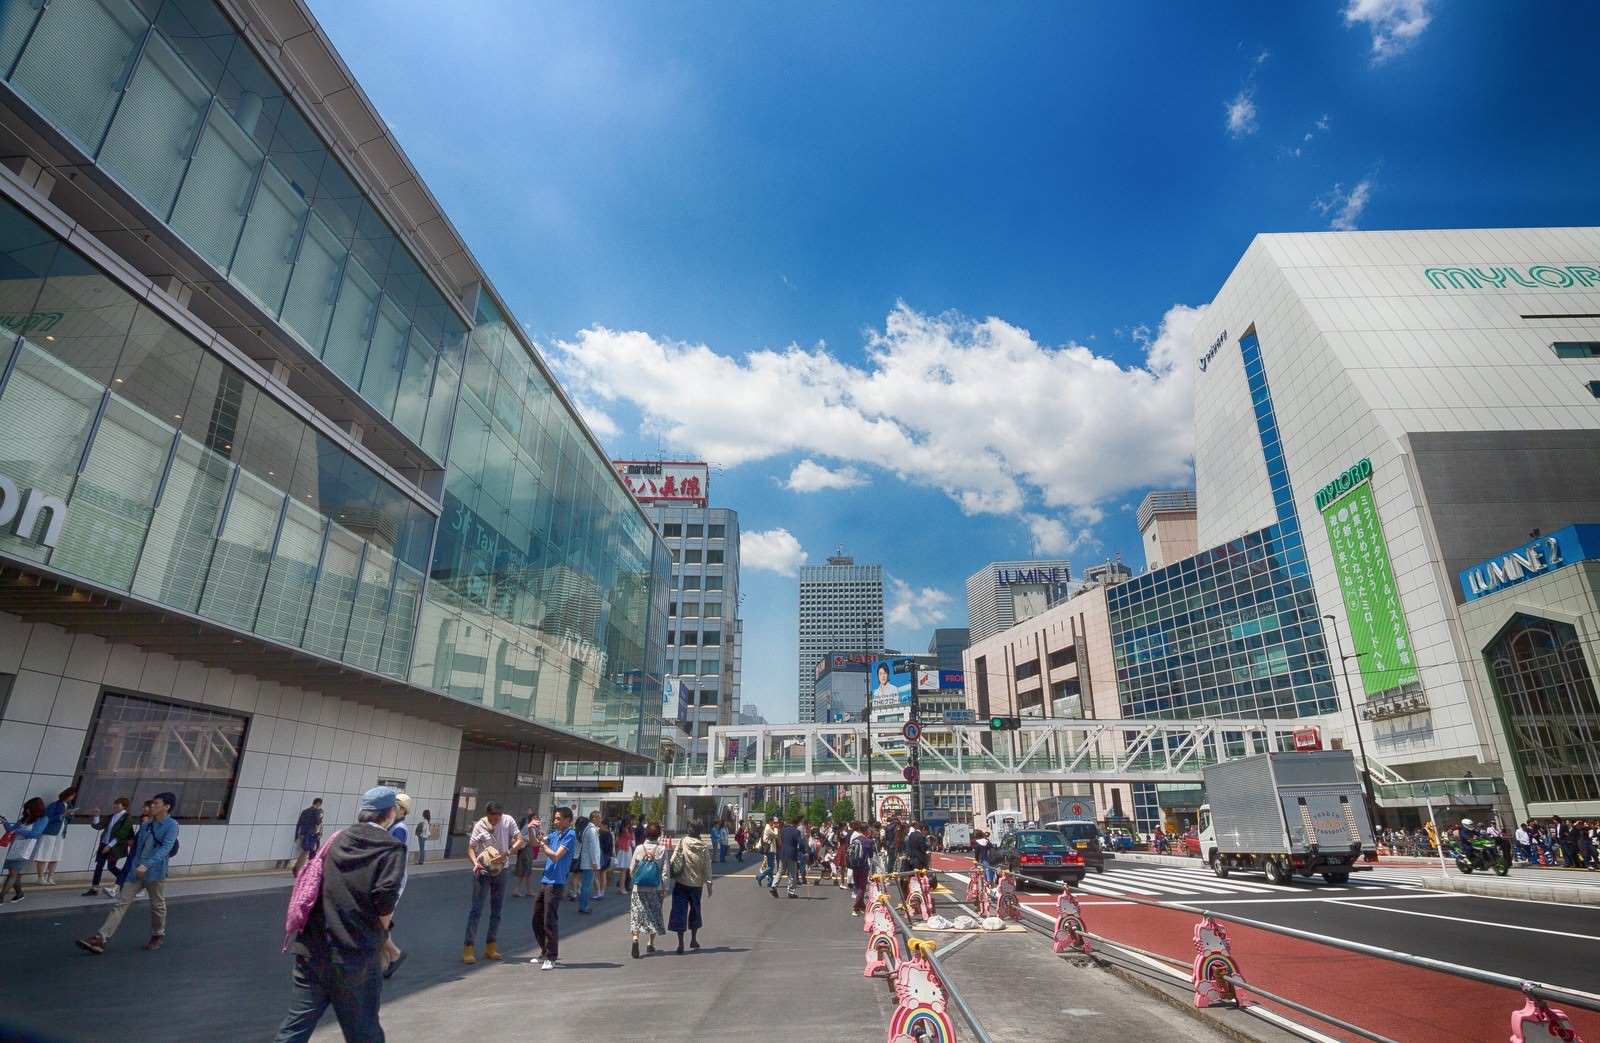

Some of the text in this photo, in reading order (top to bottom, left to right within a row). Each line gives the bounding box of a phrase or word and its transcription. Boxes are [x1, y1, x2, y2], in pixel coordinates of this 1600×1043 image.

[1314, 457, 1374, 511] MYLORD
[998, 567, 1062, 586] LUMINE
[1467, 537, 1564, 594] LUMINE 2
